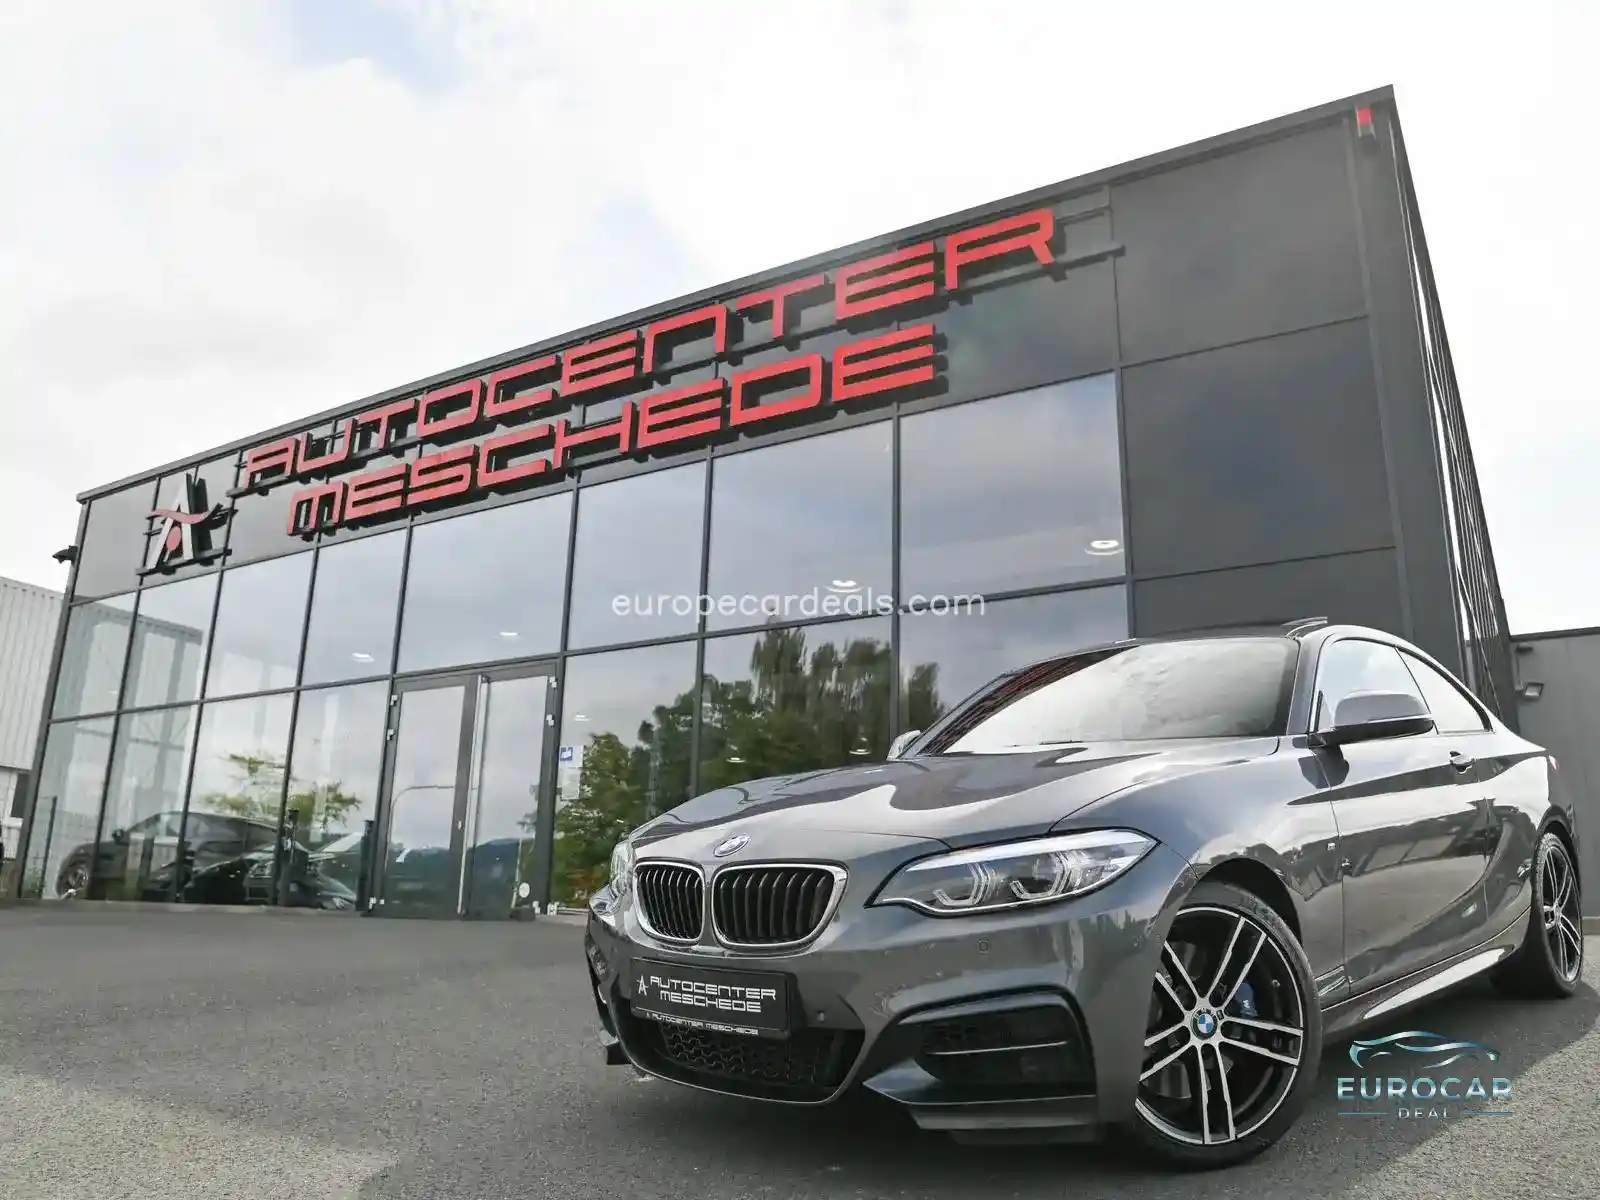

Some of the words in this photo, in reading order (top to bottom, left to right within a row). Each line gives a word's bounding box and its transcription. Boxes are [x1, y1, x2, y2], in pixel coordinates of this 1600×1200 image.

[244, 208, 1055, 490] AUTOCENTER
[286, 323, 936, 537] MESCHEDE
[650, 975, 776, 1000] AUTOCENTER
[659, 990, 762, 1013] MESCHEDE
